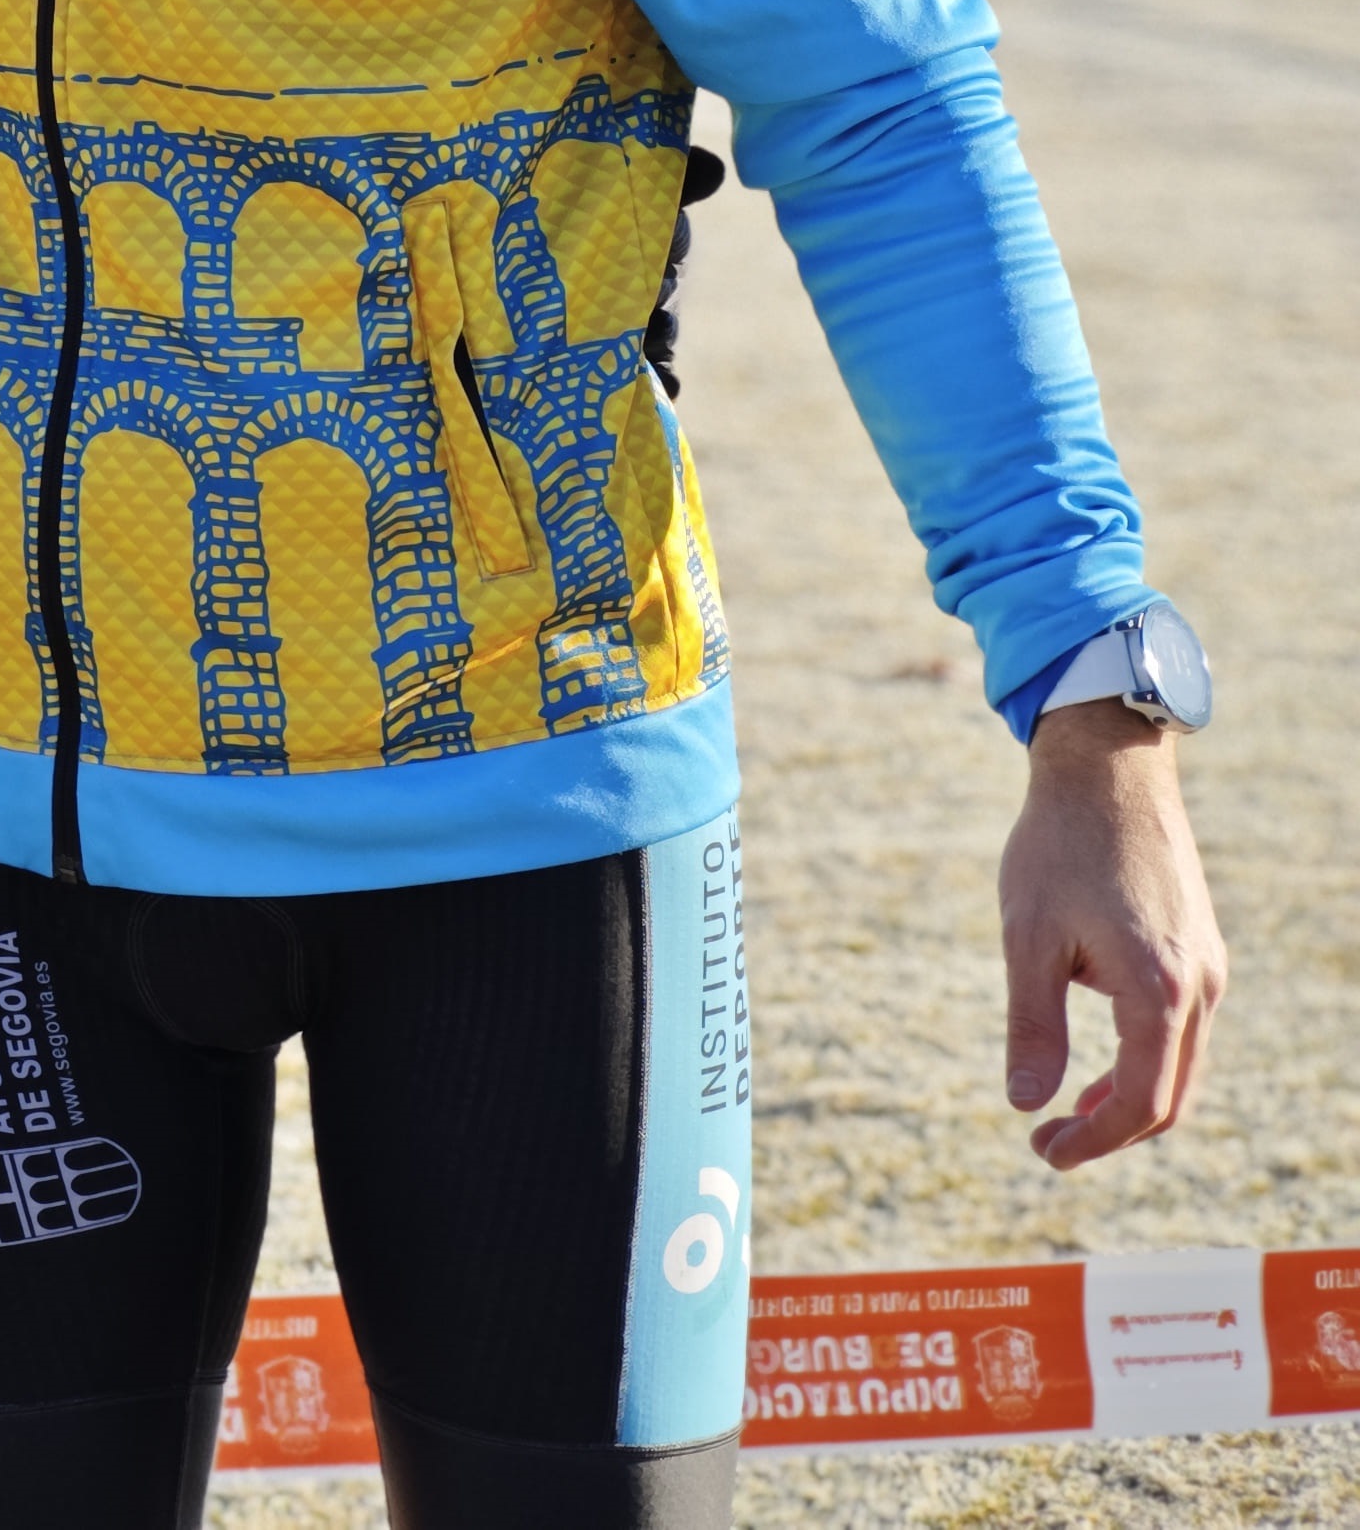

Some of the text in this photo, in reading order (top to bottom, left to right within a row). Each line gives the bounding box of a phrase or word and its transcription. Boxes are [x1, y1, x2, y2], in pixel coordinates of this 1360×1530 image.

[700, 840, 729, 1116] INSTITUTO
[34, 960, 86, 1127] www.segovia.es
[17, 1090, 57, 1134] DE
[869, 1291, 921, 1314] PARA
[927, 1286, 1030, 1311] INSTITUTO
[895, 1331, 955, 1369] DE
